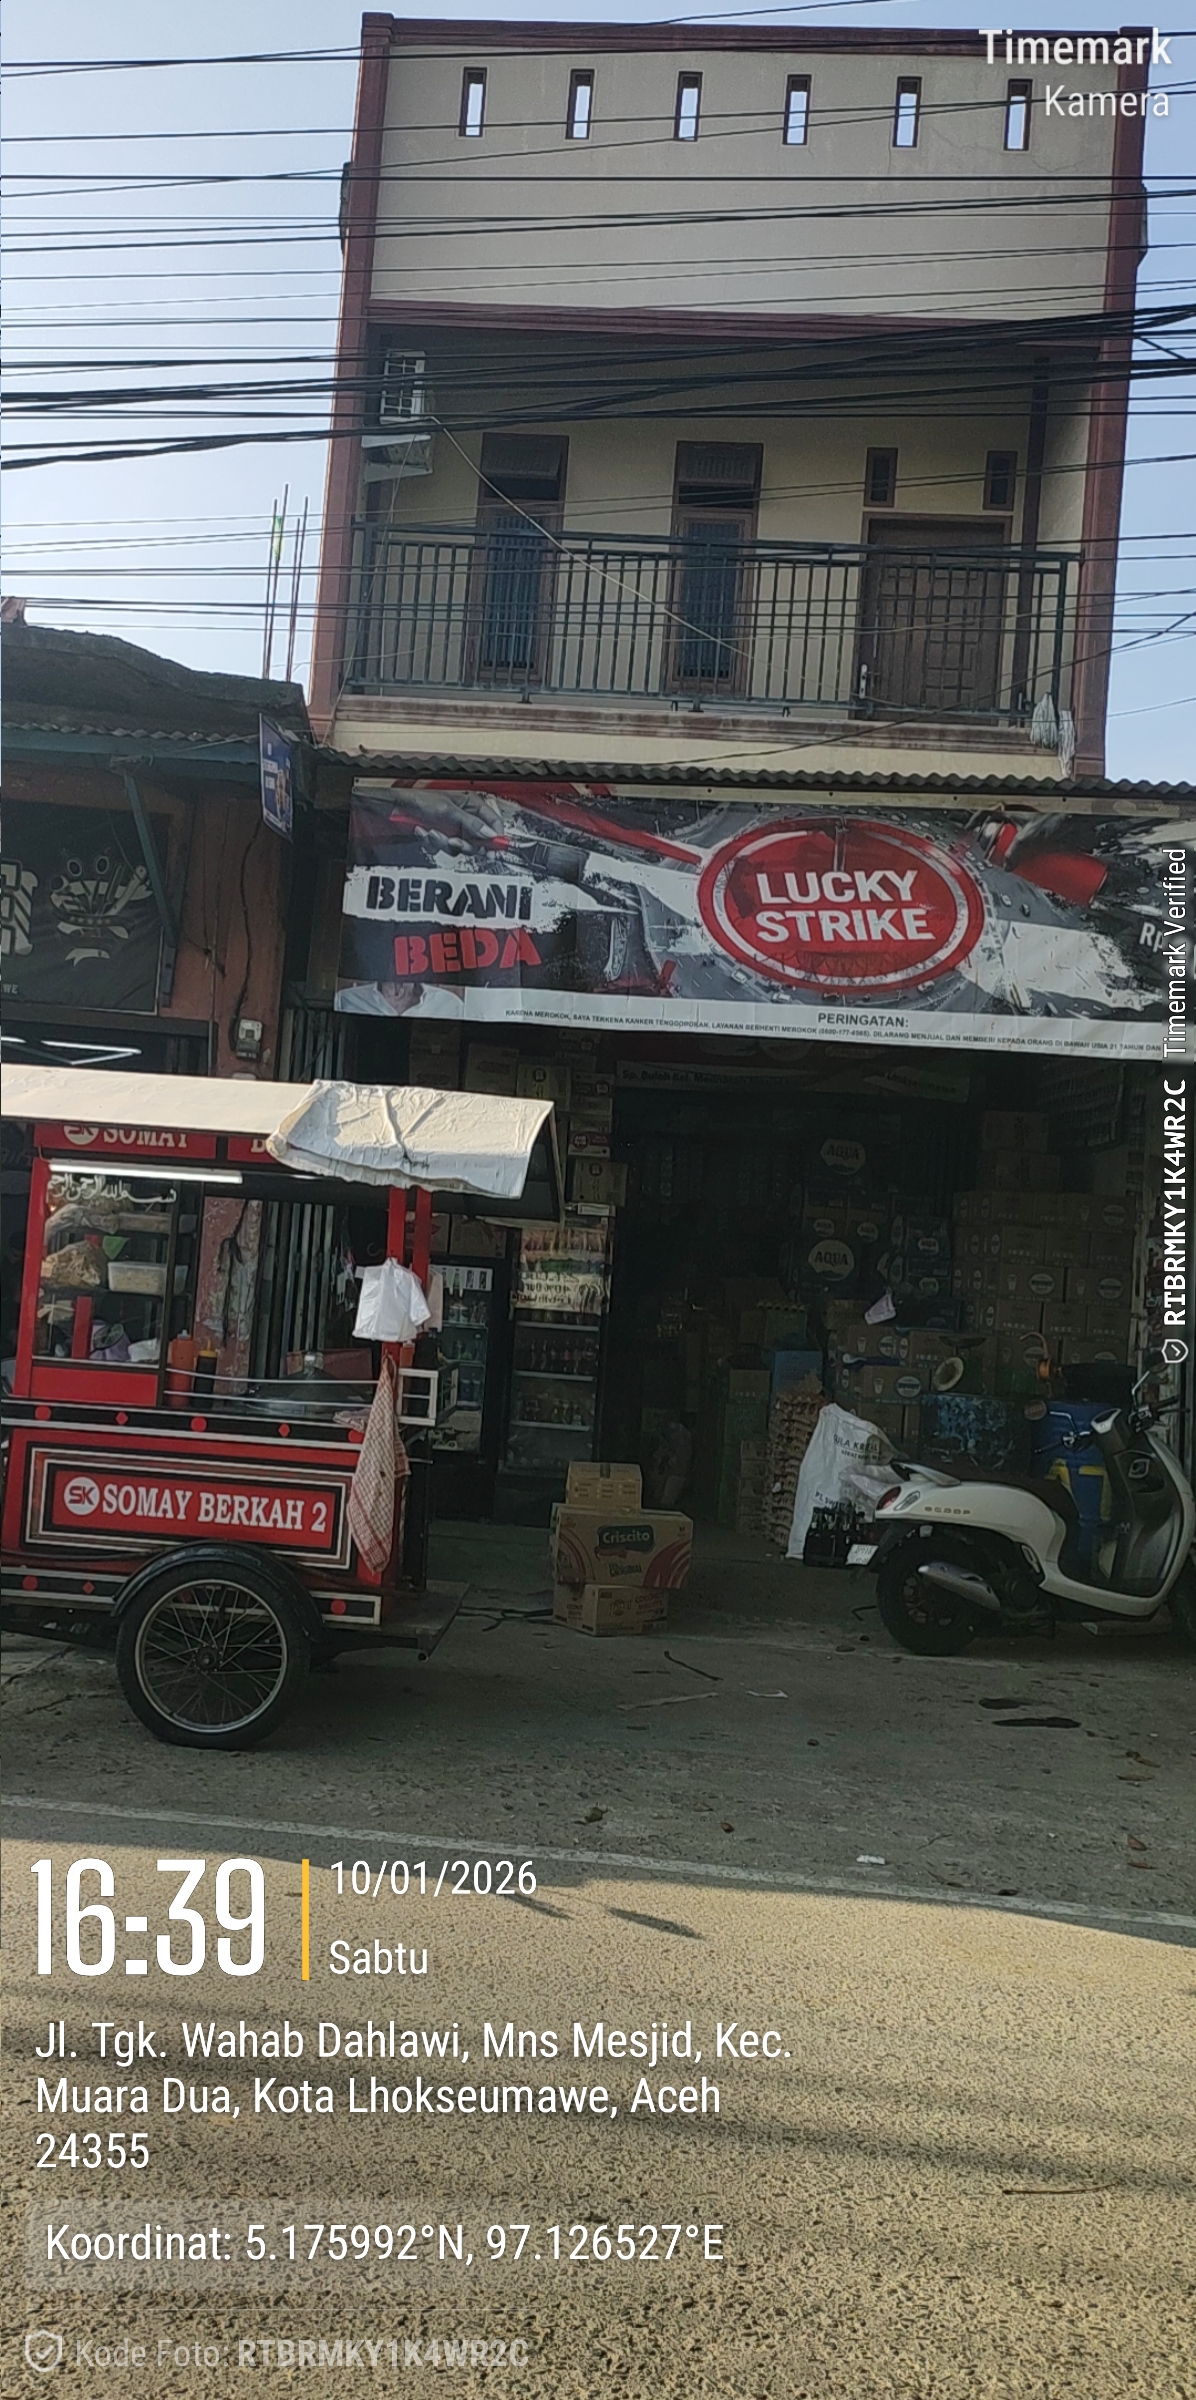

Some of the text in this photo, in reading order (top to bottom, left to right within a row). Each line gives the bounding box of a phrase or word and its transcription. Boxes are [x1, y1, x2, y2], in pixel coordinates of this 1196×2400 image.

[366, 876, 533, 920] BERANI
[756, 870, 918, 904] LUCKY
[755, 908, 936, 943] STRIKE
[394, 928, 542, 976] BEDA
[534, 1011, 571, 1021] MEROKOK,
[573, 1013, 591, 1022] SAYA
[592, 1015, 624, 1024] TERKENA
[625, 1017, 654, 1026] KANKER
[712, 1022, 744, 1031] LAYANAN
[744, 1024, 780, 1033] BERHENTI
[781, 1026, 817, 1035] MEROKOK
[873, 1030, 910, 1039] DILARANG
[910, 1032, 944, 1041] MENJUAL
[945, 1034, 961, 1042] DAN
[962, 1035, 996, 1044] MEMBERI
[997, 1037, 1025, 1045] KEPADA
[1027, 1038, 1053, 1047] ORANG
[1064, 1040, 1090, 1049] BAWAH
[1091, 1042, 1108, 1050] USIA
[1119, 1043, 1144, 1052] TAHUN
[817, 1012, 909, 1028] PERINGATAN:
[826, 1143, 860, 1161] AQUA
[814, 1251, 849, 1267] AQUA
[68, 1483, 328, 1533] SK SOMAY BERKAH 2
[602, 1529, 651, 1544] Criscito
